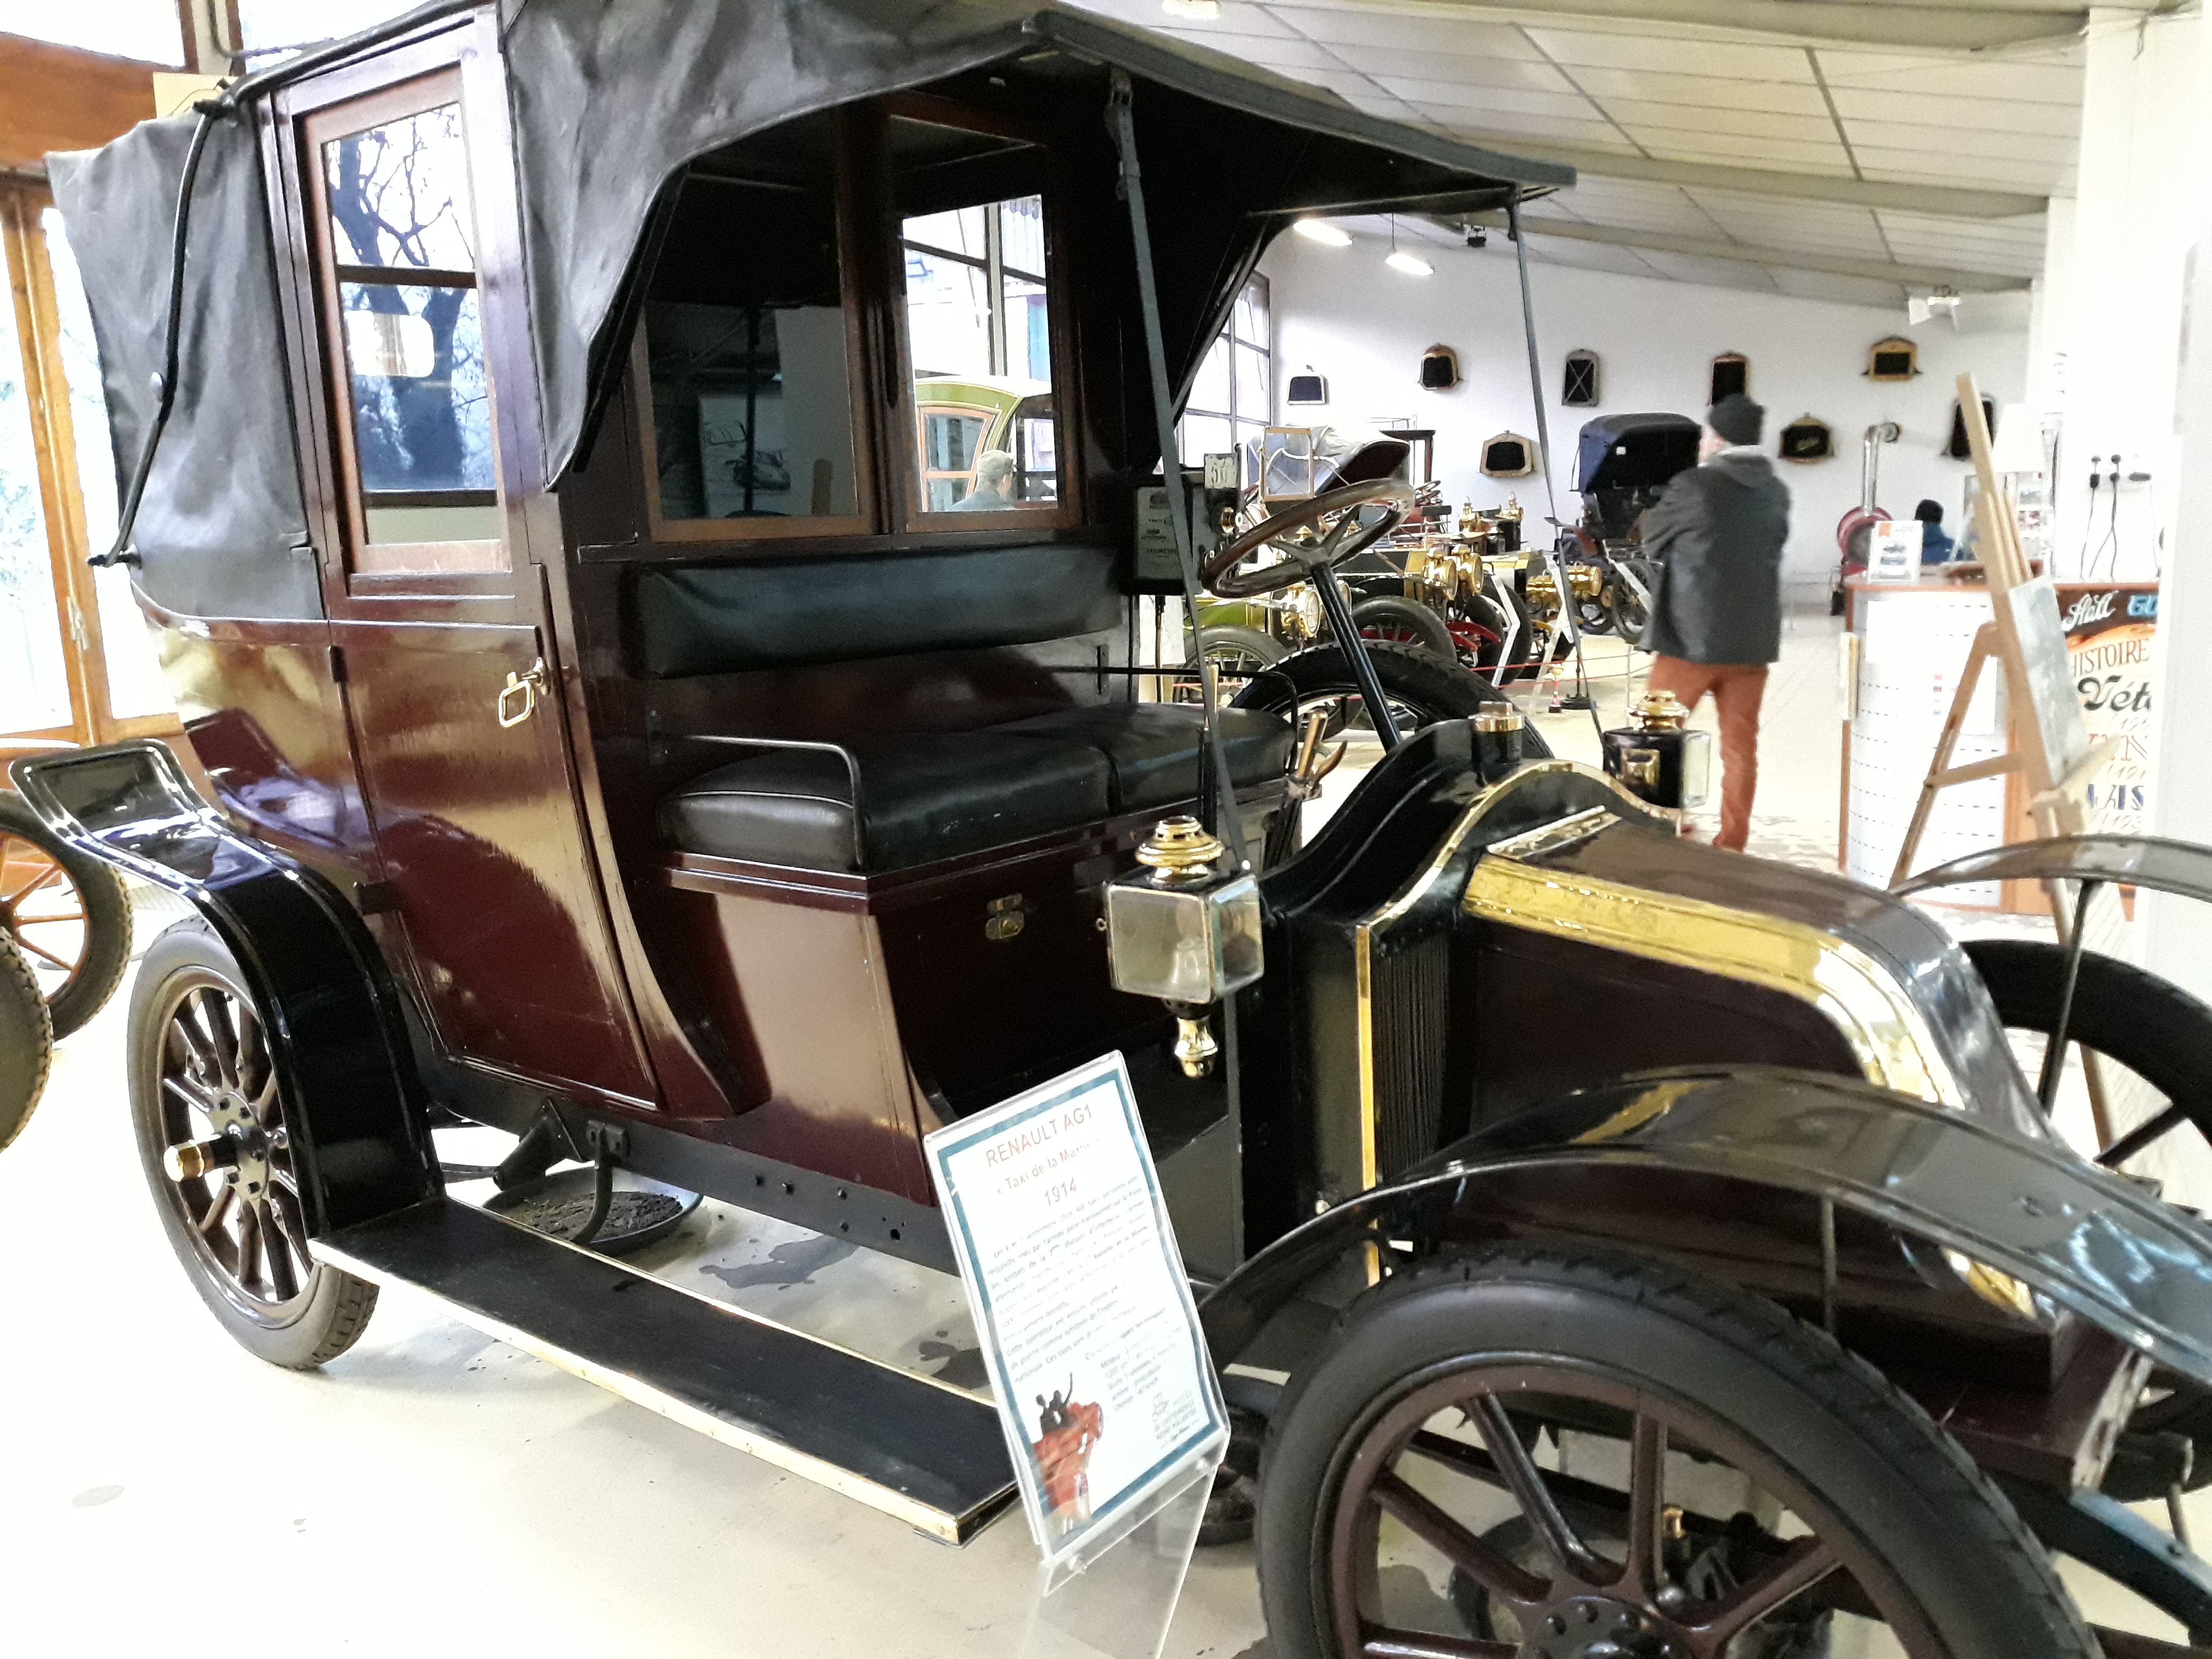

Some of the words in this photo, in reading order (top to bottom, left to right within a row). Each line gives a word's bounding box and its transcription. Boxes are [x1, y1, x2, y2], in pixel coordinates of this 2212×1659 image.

[2078, 675, 2152, 712] Vét
[985, 1119, 1057, 1167] RENAULT
[1064, 1103, 1092, 1130] AG1
[1004, 1173, 1028, 1189] Taxi
[1032, 1164, 1045, 1177] de
[1047, 1157, 1058, 1169] la
[1044, 1177, 1077, 1205] 1914
